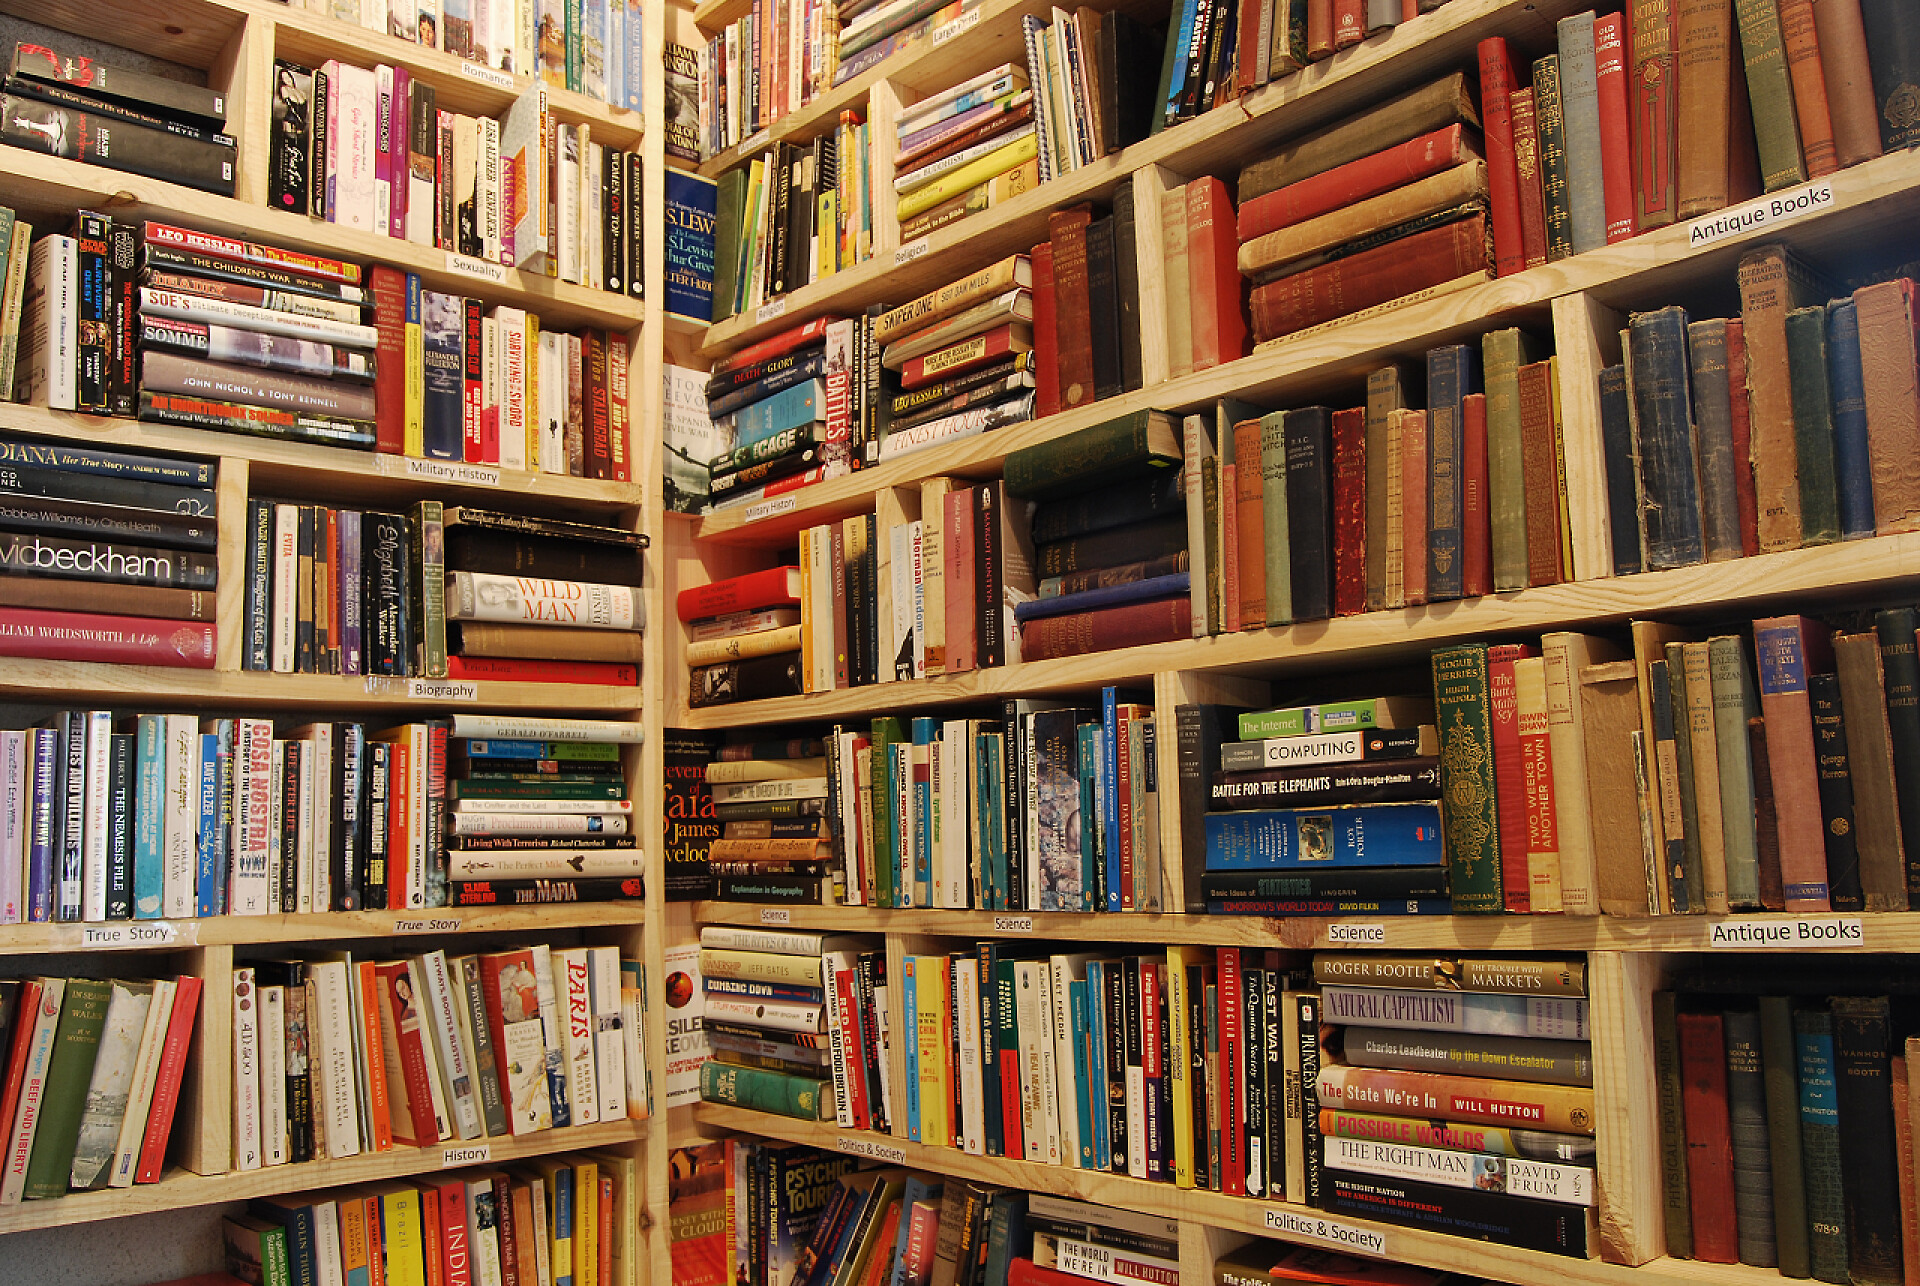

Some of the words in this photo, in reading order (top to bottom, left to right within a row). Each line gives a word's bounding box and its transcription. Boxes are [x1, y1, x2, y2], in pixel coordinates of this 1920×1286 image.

[464, 64, 512, 87] Romance
[1691, 207, 1765, 242] Antique
[1771, 187, 1831, 216] Books
[895, 243, 926, 263] Religion
[192, 257, 210, 268] THE
[213, 260, 266, 279] CHILDREN'S
[269, 271, 289, 283] WAR
[453, 257, 501, 279] Sexuality
[150, 291, 189, 309] SOE's
[884, 308, 915, 330] SNIPER
[915, 300, 934, 317] ONE
[941, 289, 954, 303] SGT
[954, 283, 971, 297] DAN
[966, 274, 989, 293] MILLS
[146, 328, 207, 348] SOMME
[734, 368, 761, 384] DEATH
[767, 357, 793, 372] GLORY
[184, 377, 211, 389] JOHN
[216, 381, 252, 394] NICHOL
[258, 389, 265, 397] &
[269, 390, 293, 400] TONY
[827, 374, 846, 441] BATTLES
[594, 387, 606, 458] STALINGRAD
[895, 427, 935, 449] FINEST
[933, 409, 985, 441] HOUR
[1265, 425, 1278, 433] THE
[1262, 441, 1285, 452] WITCH
[1263, 432, 1284, 442] WHITE
[0, 443, 58, 465] DIANA
[62, 455, 78, 464] Her
[81, 457, 99, 467] True
[102, 460, 123, 471] Story
[412, 462, 454, 475] Military
[459, 468, 497, 482] History
[747, 504, 768, 516] Military
[770, 499, 794, 512] History
[40, 512, 82, 524] Williams
[85, 516, 99, 527] by
[101, 518, 128, 529] Chris
[129, 522, 161, 533] Heath
[284, 533, 293, 557] EVITA
[913, 536, 922, 584] Norman
[517, 578, 581, 600] WILD
[523, 600, 577, 623] MAN
[915, 585, 923, 633] Wisdom
[39, 627, 122, 642] WORDSWORTH
[140, 633, 159, 646] Life
[1438, 669, 1478, 680] HERRIES
[1440, 659, 1474, 670] ROGUE
[415, 684, 473, 698] Biography
[1243, 722, 1258, 733] The
[1260, 719, 1296, 730] Internet
[1519, 712, 1548, 722] IRWIN
[1519, 722, 1548, 731] SHAW
[252, 724, 271, 769] COSA
[1119, 718, 1129, 784] LONGITUDE
[1269, 741, 1355, 760] COMPUTING
[1526, 742, 1533, 758] IN
[1536, 739, 1547, 786] TOWN
[1212, 785, 1241, 798] BATTLE
[1244, 783, 1260, 795] FOR
[1262, 782, 1277, 794] THE
[1280, 778, 1329, 792] ELEPHANTS
[1528, 765, 1537, 810] WEEKS
[249, 776, 270, 852] NOSTRA
[491, 817, 540, 830] Proclaimed
[543, 818, 550, 830] in
[553, 818, 583, 830] Blood
[1539, 793, 1552, 848] ANOTHER
[673, 823, 718, 844] James
[1356, 817, 1364, 856] PORTER
[1530, 819, 1540, 846] TWO
[514, 890, 536, 902] THE
[536, 882, 577, 901] MAFIA
[762, 910, 787, 921] Science
[1224, 901, 1274, 911] TOMORROW'S
[1277, 902, 1307, 911] WORLD
[1308, 902, 1334, 911] TODAY
[1339, 903, 1357, 911] DAVID
[1359, 903, 1379, 911] FILKIN
[87, 930, 120, 942] True
[130, 927, 168, 940] Story
[396, 920, 423, 930] True
[429, 919, 460, 930] Story
[995, 918, 1031, 930] Science
[1330, 926, 1383, 940] Science
[1713, 924, 1791, 943] Antique
[1798, 921, 1861, 939] Books
[1324, 962, 1370, 976] ROGER
[1376, 965, 1429, 979] BOOTLE
[1472, 975, 1541, 988] MARKETS
[567, 959, 588, 1039] PARIS
[1266, 972, 1277, 1017] LAST
[1329, 993, 1381, 1018] NATURAL
[1383, 995, 1454, 1023] CAPITALISM
[1268, 1021, 1277, 1062] WAR
[1302, 1034, 1315, 1095] PRINCESS
[1366, 1041, 1397, 1054] Charles
[1399, 1043, 1447, 1059] Leadbeater
[1450, 1050, 1461, 1062] Up
[1464, 1051, 1479, 1061] the
[1482, 1052, 1507, 1064] Down
[1510, 1055, 1554, 1070] Escalator
[1840, 1050, 1887, 1058] IVANHOE
[29, 1079, 41, 1104] BEEF
[1323, 1082, 1341, 1098] The
[1347, 1085, 1379, 1102] State
[1384, 1089, 1418, 1107] We're
[1424, 1091, 1436, 1109] In
[1659, 1037, 1676, 1140] DEVELOPMENT
[22, 1106, 35, 1129] AND
[1306, 1097, 1315, 1130] JEAN
[1455, 1100, 1484, 1112] WILL
[1490, 1104, 1540, 1118] HUTTON
[1338, 1116, 1410, 1141] POSSIBLE
[1416, 1126, 1484, 1150] WORLDS
[13, 1132, 31, 1175] LIBERTY
[445, 1149, 486, 1161] History
[839, 1139, 864, 1153] Politics
[867, 1143, 874, 1152] &
[876, 1145, 905, 1163] Society
[1339, 1141, 1369, 1159] THE
[1375, 1146, 1422, 1168] RIGHT
[1428, 1152, 1467, 1172] MAN
[1308, 1148, 1318, 1197] SASSON
[1511, 1164, 1561, 1181] DAVID
[1667, 1145, 1679, 1208] PHYSICAL
[1513, 1178, 1557, 1195] FRUM
[681, 1219, 724, 1238] CLOUD
[1266, 1212, 1312, 1236] Politics
[1316, 1222, 1327, 1236] &
[1331, 1224, 1383, 1251] Society
[908, 1216, 923, 1279] ARABESK
[1064, 1243, 1078, 1256] THE
[1081, 1246, 1108, 1263] WORLD
[1063, 1256, 1088, 1272] WE'RE
[1097, 1266, 1108, 1276] IN
[1116, 1260, 1138, 1277] WILL
